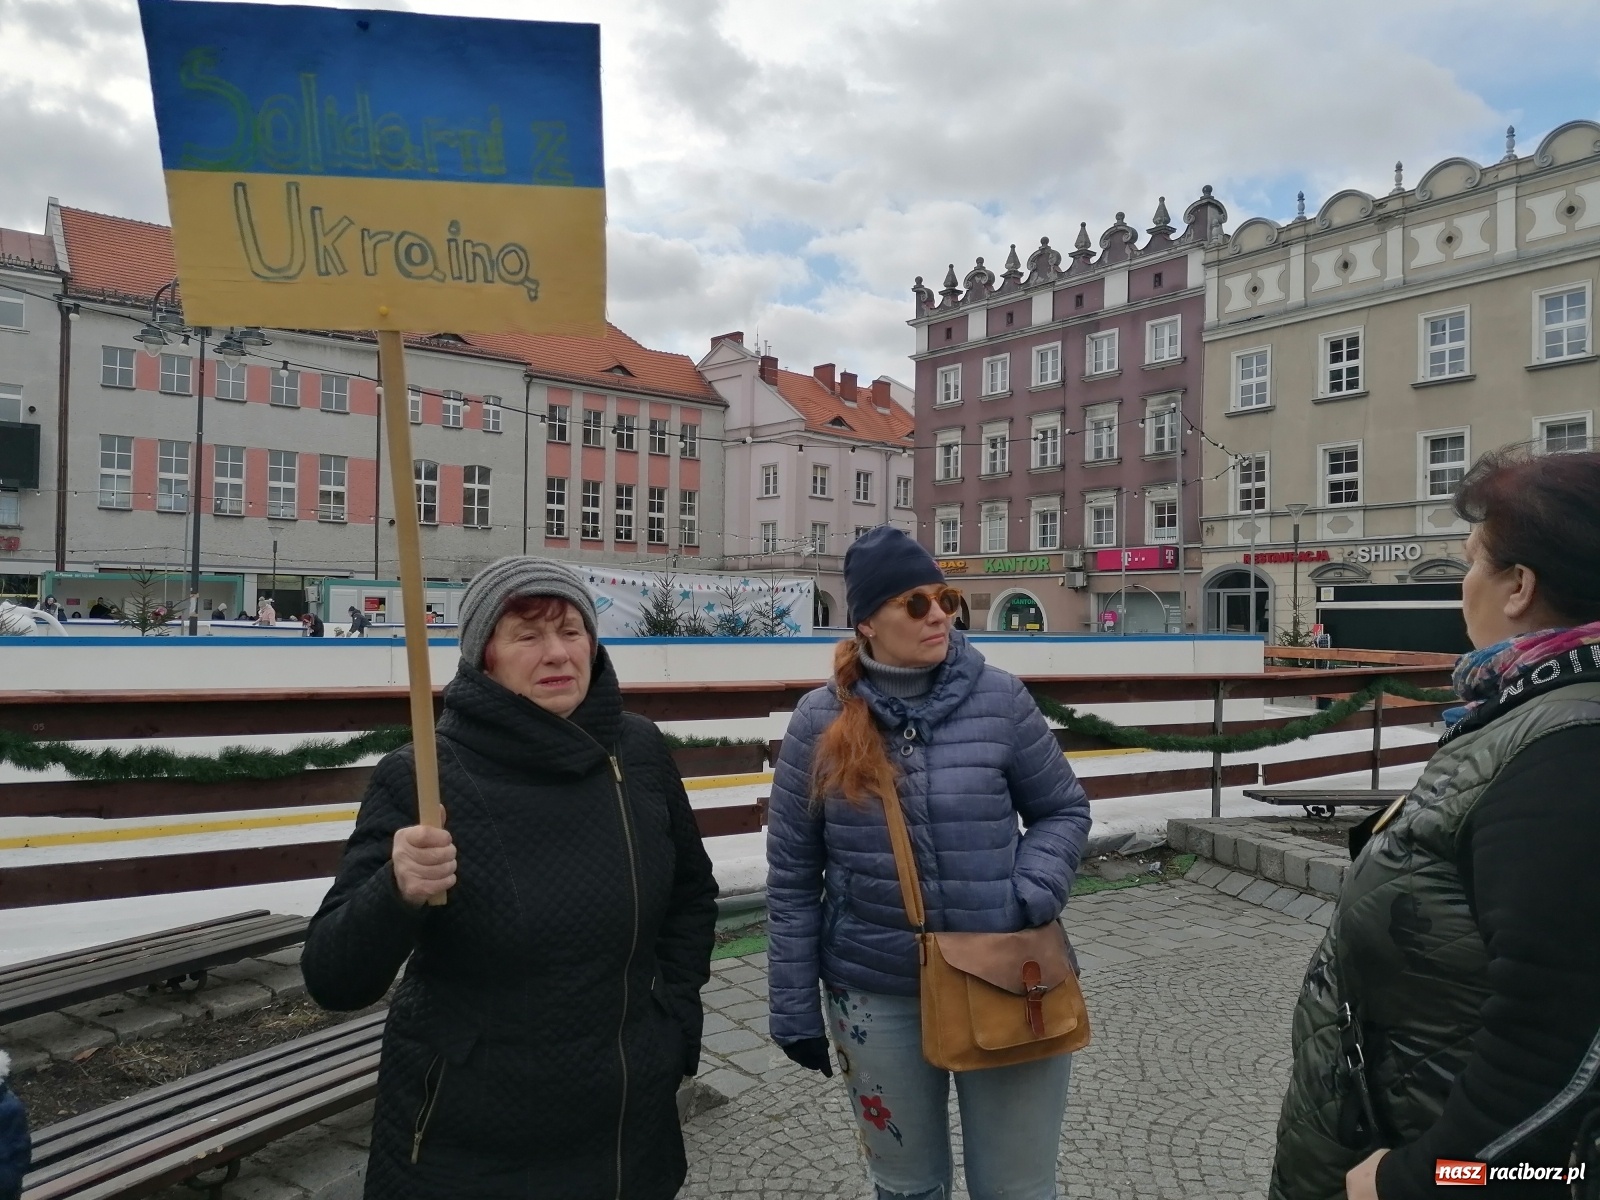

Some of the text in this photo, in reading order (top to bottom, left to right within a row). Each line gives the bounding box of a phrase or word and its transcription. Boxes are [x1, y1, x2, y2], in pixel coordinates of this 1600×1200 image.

[179, 46, 506, 176] Solidarni
[233, 182, 540, 302] Ukrainą
[1165, 549, 1174, 564] T
[1243, 550, 1330, 565] RESTAURACJA
[1357, 543, 1422, 563] SHIRO
[984, 556, 1050, 573] KANTOR
